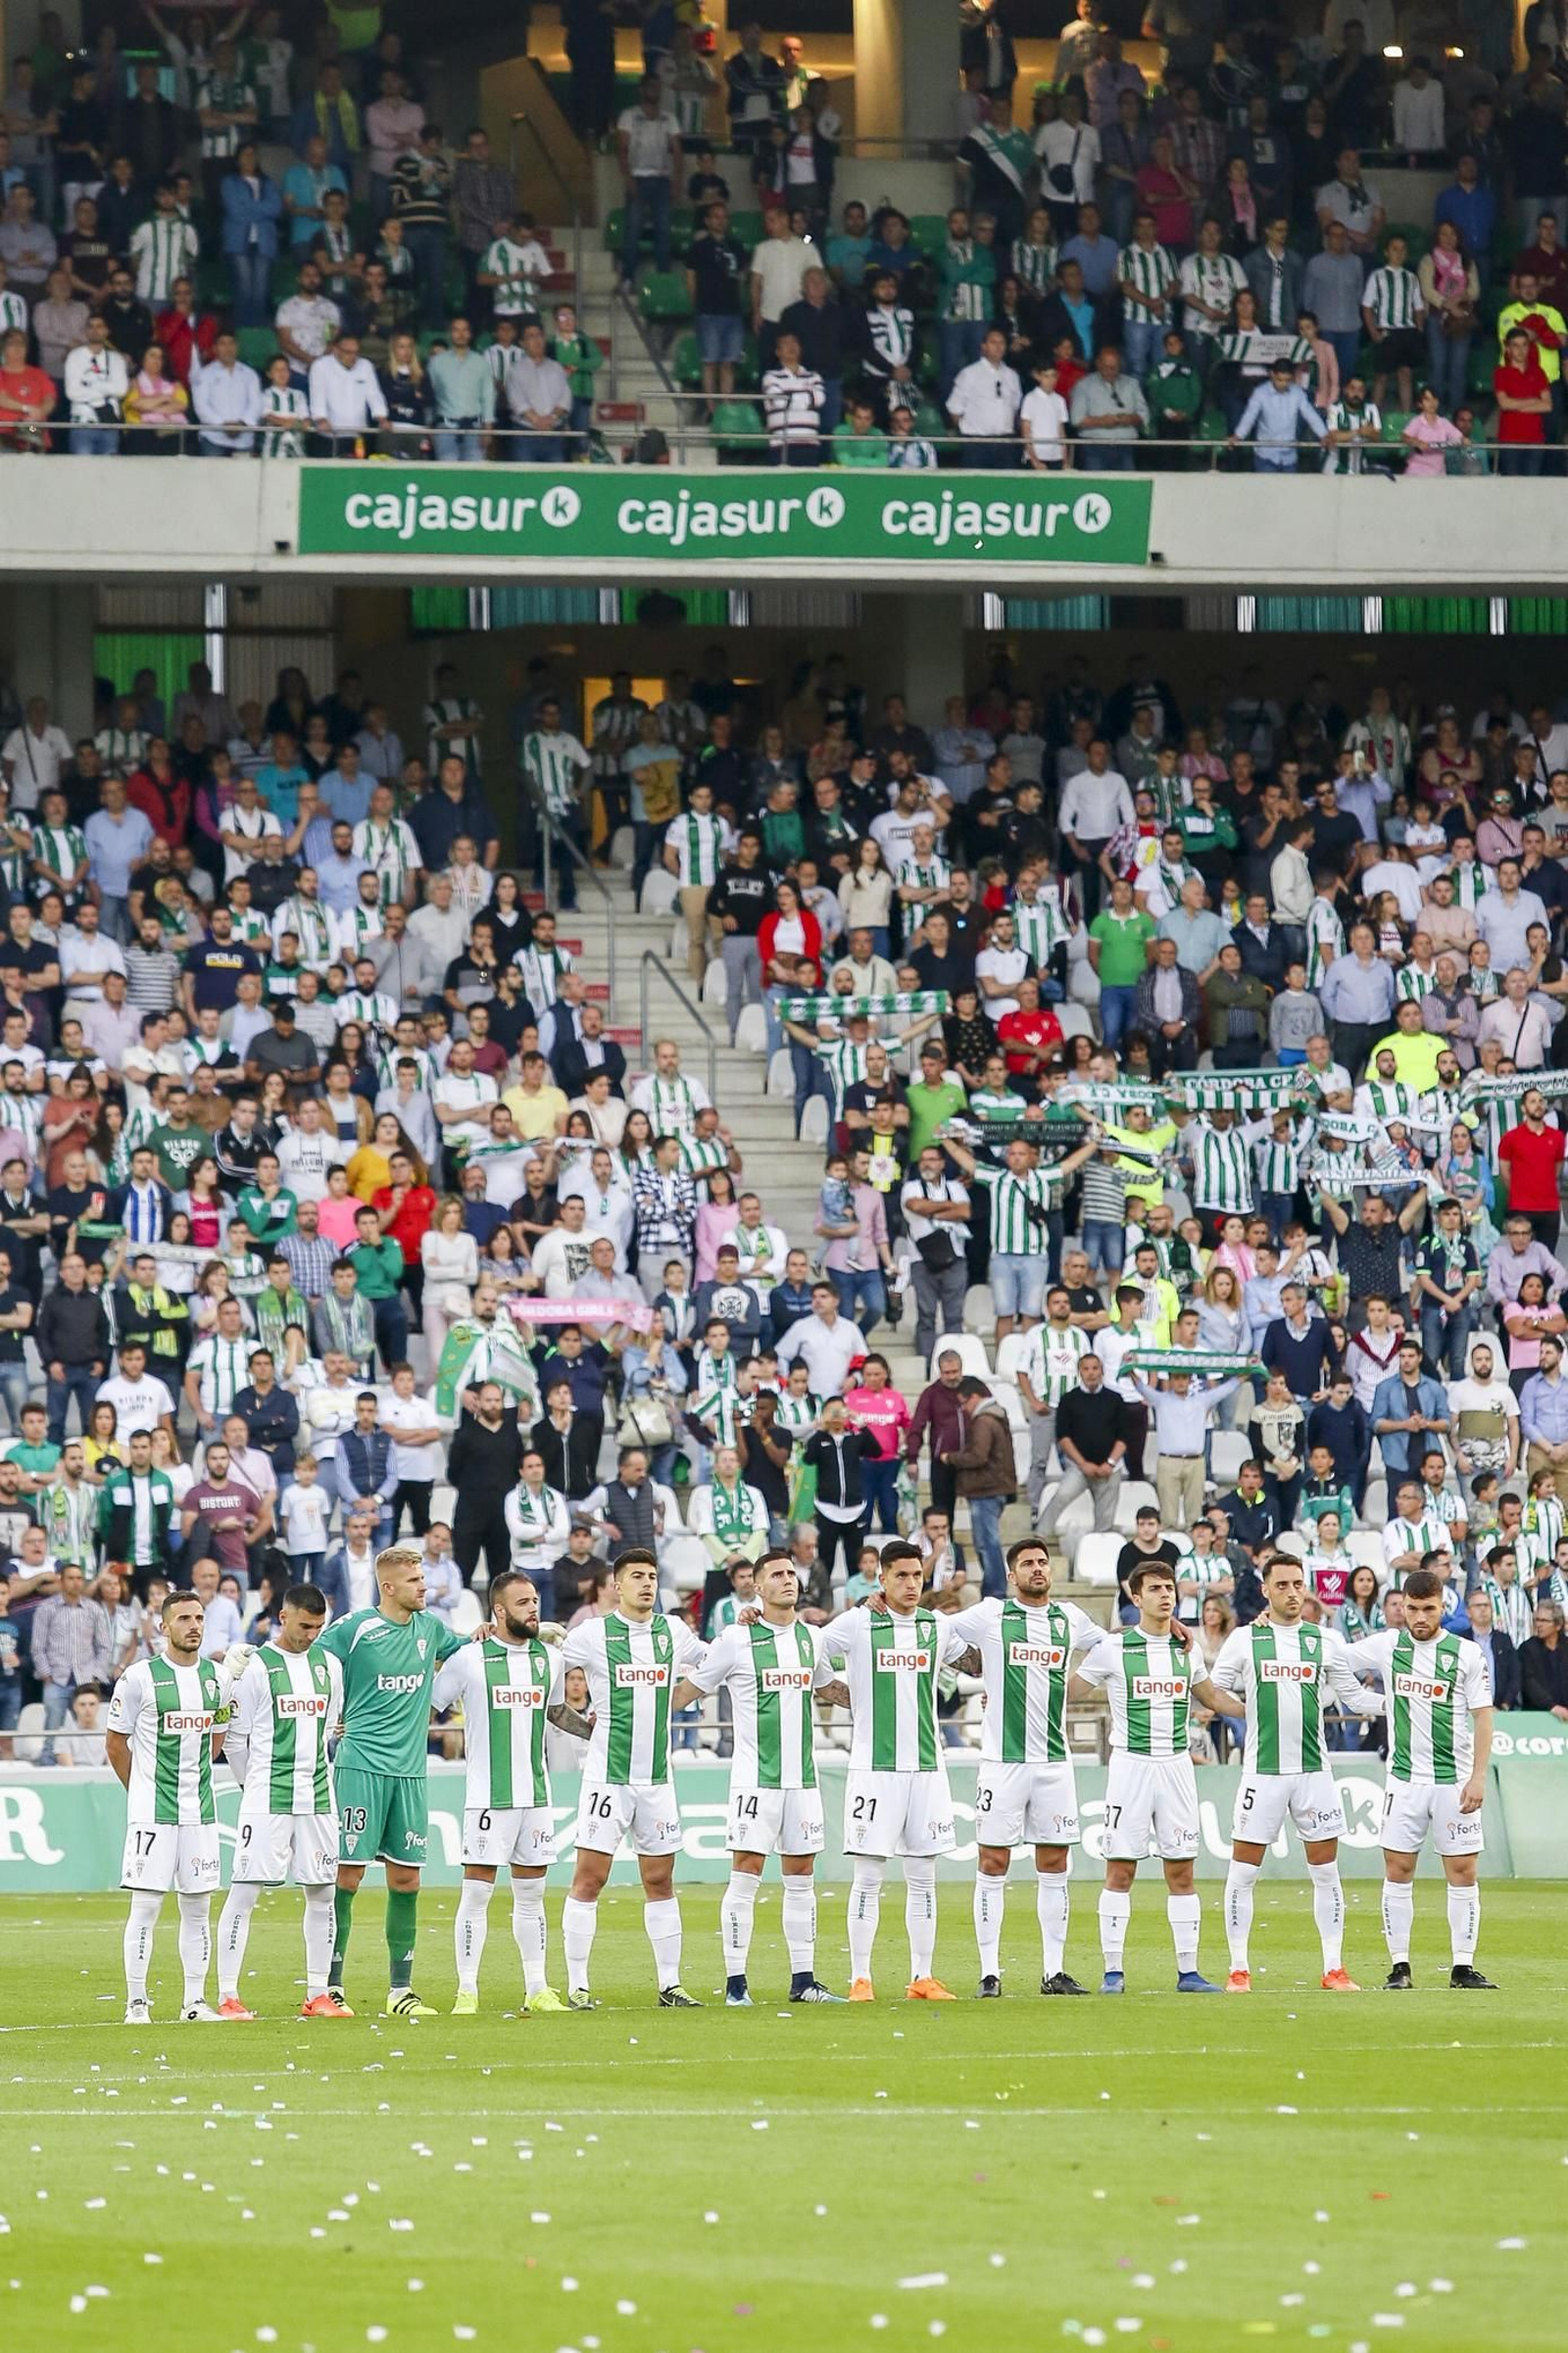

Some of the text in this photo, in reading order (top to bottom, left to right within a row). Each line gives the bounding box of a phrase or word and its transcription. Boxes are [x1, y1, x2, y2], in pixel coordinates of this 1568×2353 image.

[345, 483, 536, 539] cajasur
[618, 489, 802, 546] cajasur
[882, 490, 1069, 546] cajasur
[880, 1652, 927, 1670] tango
[1012, 1645, 1060, 1666] tango
[377, 1674, 424, 1692] tango
[619, 1669, 664, 1685] tango
[765, 1671, 810, 1689] tango
[1263, 1665, 1312, 1682] tango
[496, 1689, 541, 1705] tango
[1137, 1680, 1184, 1696] tango
[1397, 1675, 1444, 1697] tango
[279, 1698, 324, 1716] tango
[167, 1715, 212, 1732] tango
[1492, 1730, 1568, 1755] @cor
[590, 1792, 612, 1819] 16
[736, 1794, 759, 1820] 14
[853, 1795, 877, 1822] 21
[1243, 1788, 1256, 1810] 5
[343, 1806, 367, 1833] 13
[479, 1808, 491, 1831] 6
[136, 1831, 156, 1855] 17
[241, 1825, 253, 1848] 9
